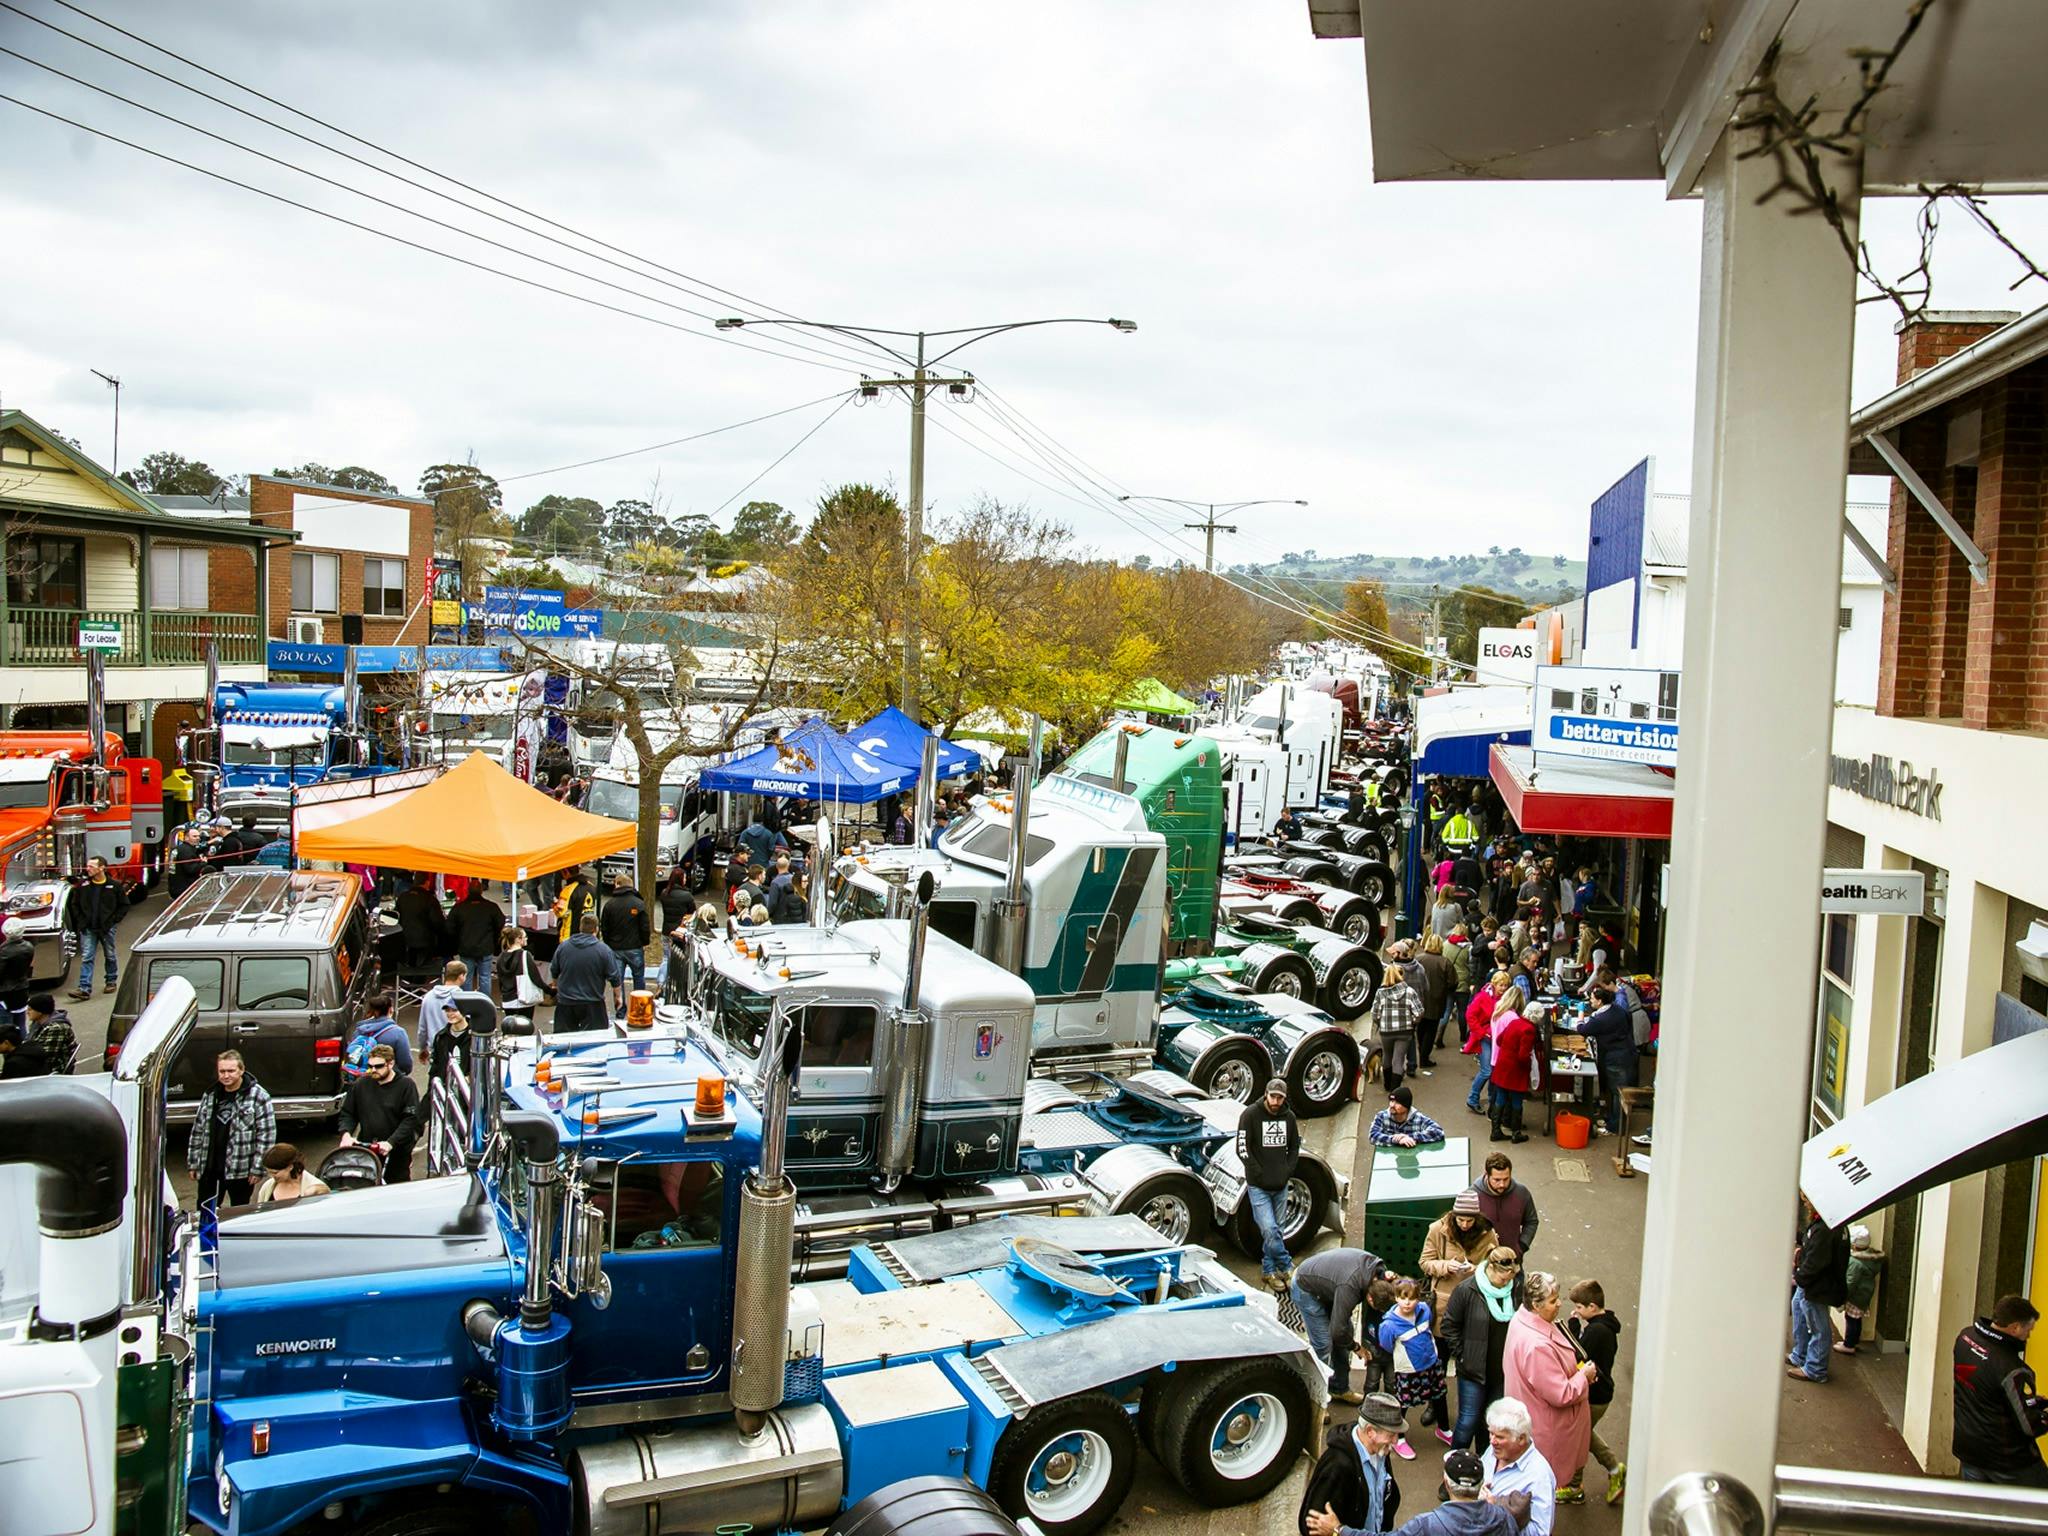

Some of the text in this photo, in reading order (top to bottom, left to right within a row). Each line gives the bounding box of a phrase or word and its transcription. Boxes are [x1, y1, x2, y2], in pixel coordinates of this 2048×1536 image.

[84, 633, 117, 643] For Lease
[1483, 643, 1533, 659] ELGAS
[1581, 745, 1662, 762] appliance centre
[753, 779, 798, 792] KINCROME
[1871, 885, 1908, 900] Bank
[1239, 1130, 1248, 1158] REEF
[1265, 1137, 1286, 1145] REEF
[1838, 1156, 1872, 1186] ATM
[256, 1338, 336, 1355] KENWORTH
